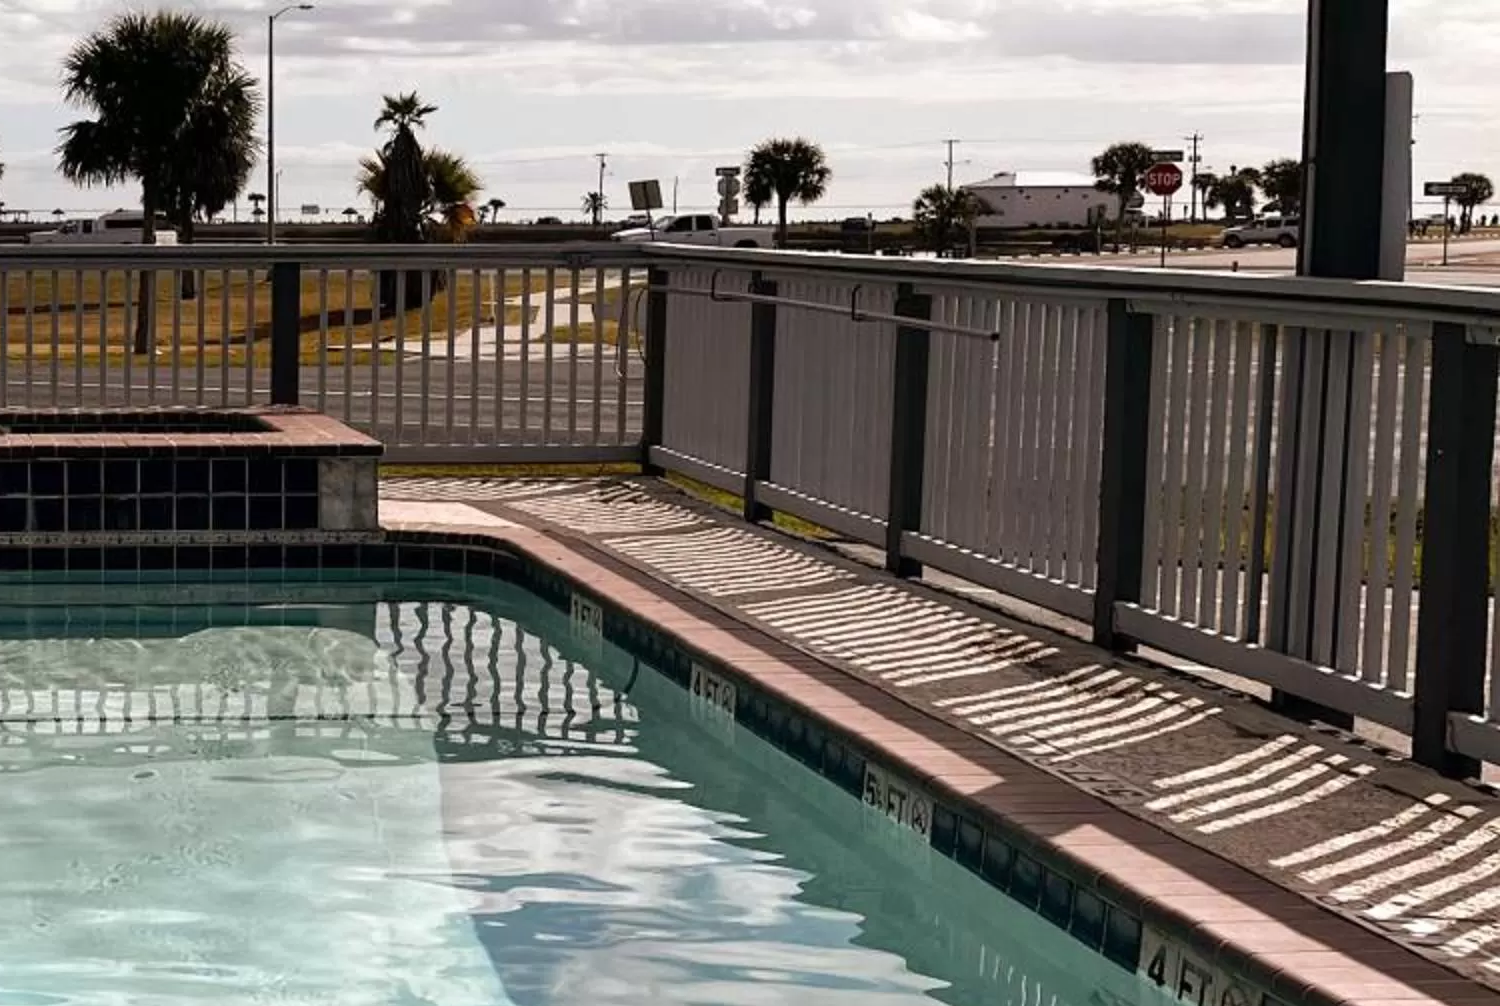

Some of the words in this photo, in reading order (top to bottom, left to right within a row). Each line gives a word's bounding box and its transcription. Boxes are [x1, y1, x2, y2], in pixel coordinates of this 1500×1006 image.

[1149, 172, 1181, 187] STOP
[885, 784, 907, 824] FT
[1147, 945, 1167, 988] 4
